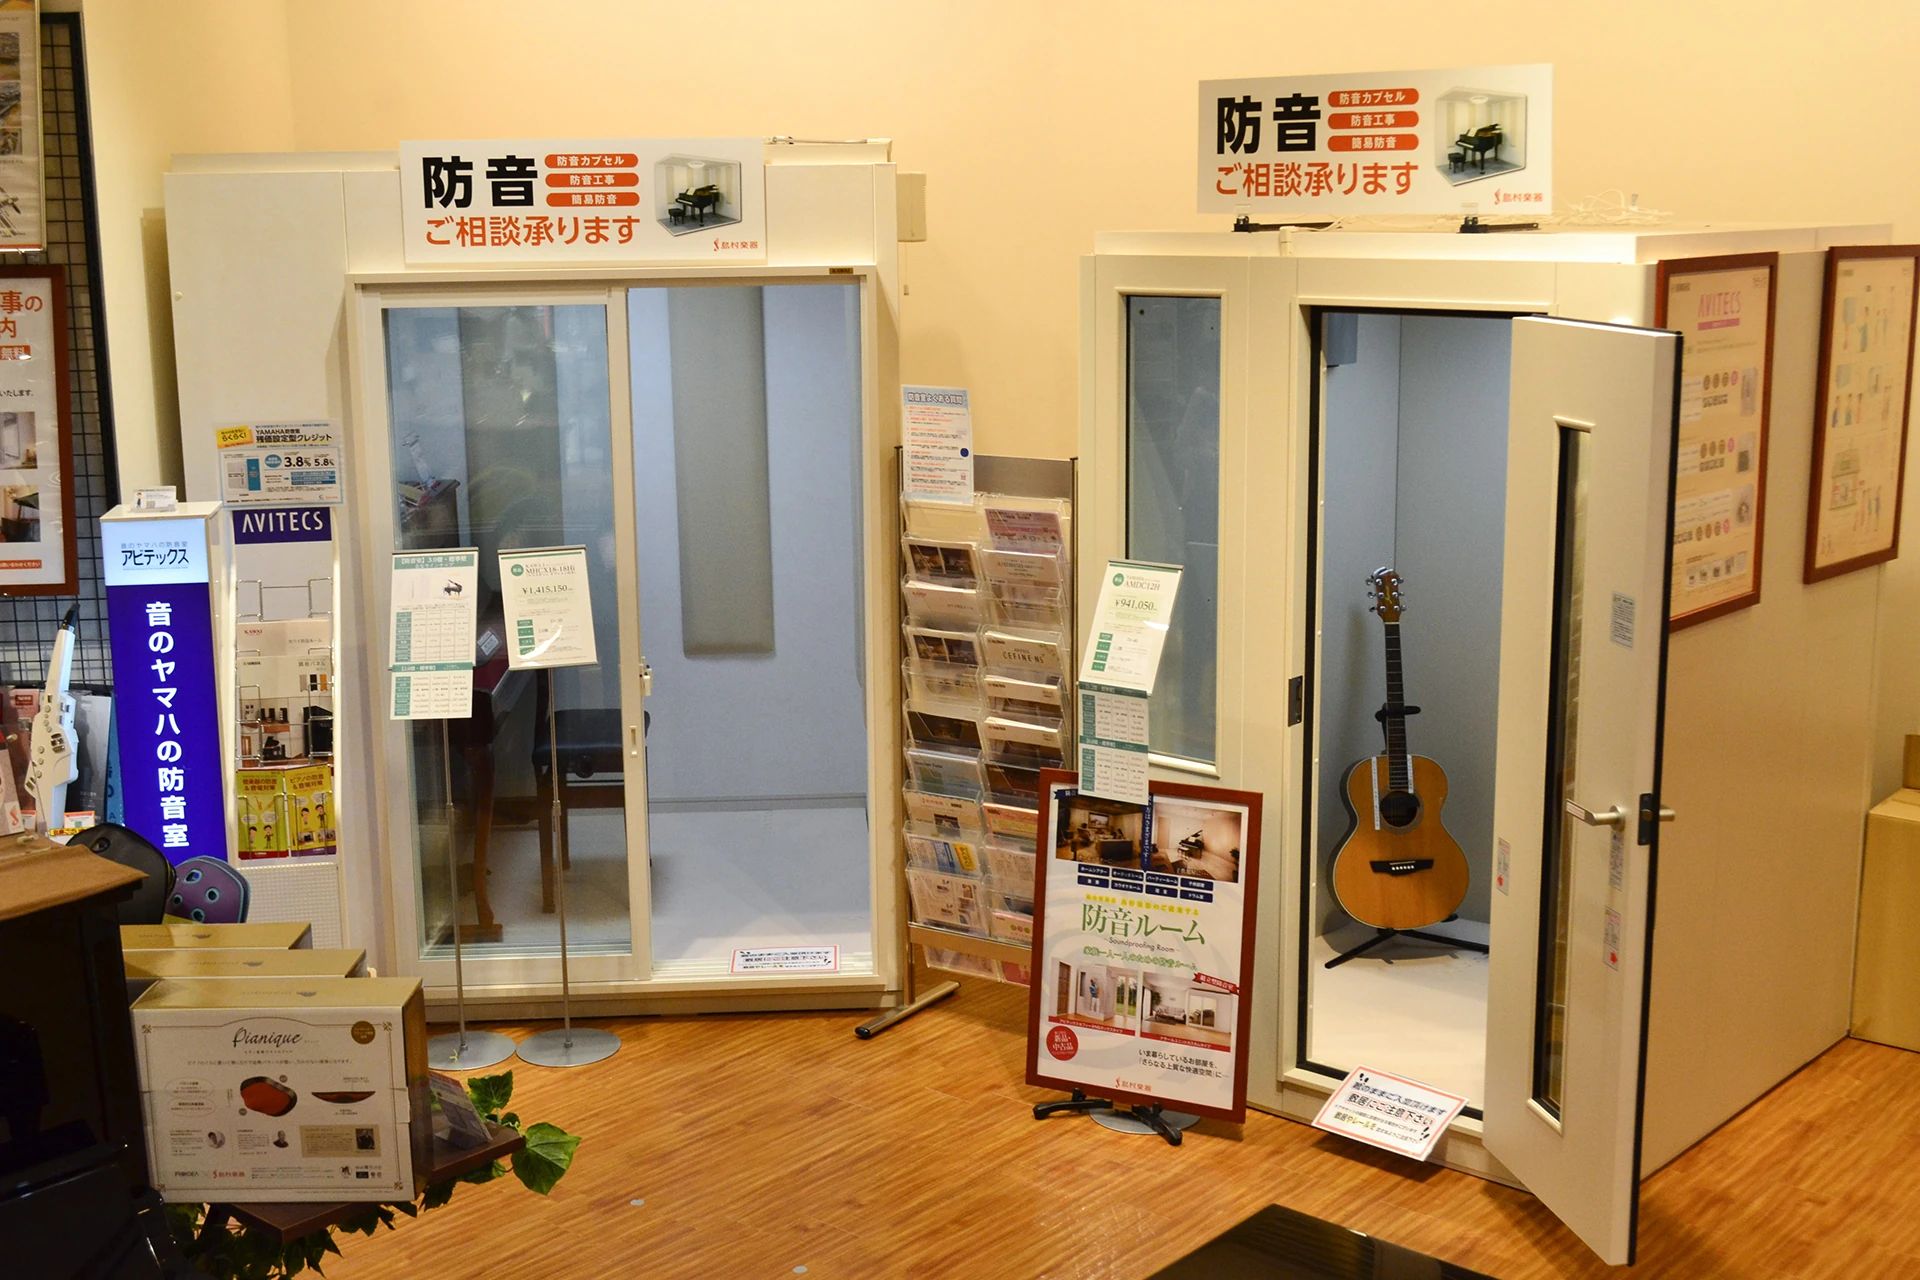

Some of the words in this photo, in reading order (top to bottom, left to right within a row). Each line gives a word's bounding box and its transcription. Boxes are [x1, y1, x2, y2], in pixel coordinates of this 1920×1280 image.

[1339, 91, 1405, 105] 防音カプセル
[1217, 93, 1321, 155] 防音
[1351, 114, 1396, 126] 防音工事
[1351, 136, 1397, 149] 簡易防音
[556, 155, 625, 166] 防音カプセル
[422, 155, 538, 209] 防音
[569, 174, 616, 186] 防音工事
[1216, 161, 1419, 197] ご相談承ります
[571, 194, 617, 206] 簡易防音
[426, 216, 641, 248] ご相談承ります
[242, 511, 324, 533] AVITECS
[121, 548, 189, 566] アビテックス
[145, 601, 190, 848] 音のヤマハの防音室
[1082, 903, 1205, 945] 防音ルーム
[1109, 937, 1155, 952] Soundproofing
[1157, 944, 1175, 953] Room
[232, 1026, 303, 1048] Pianique
